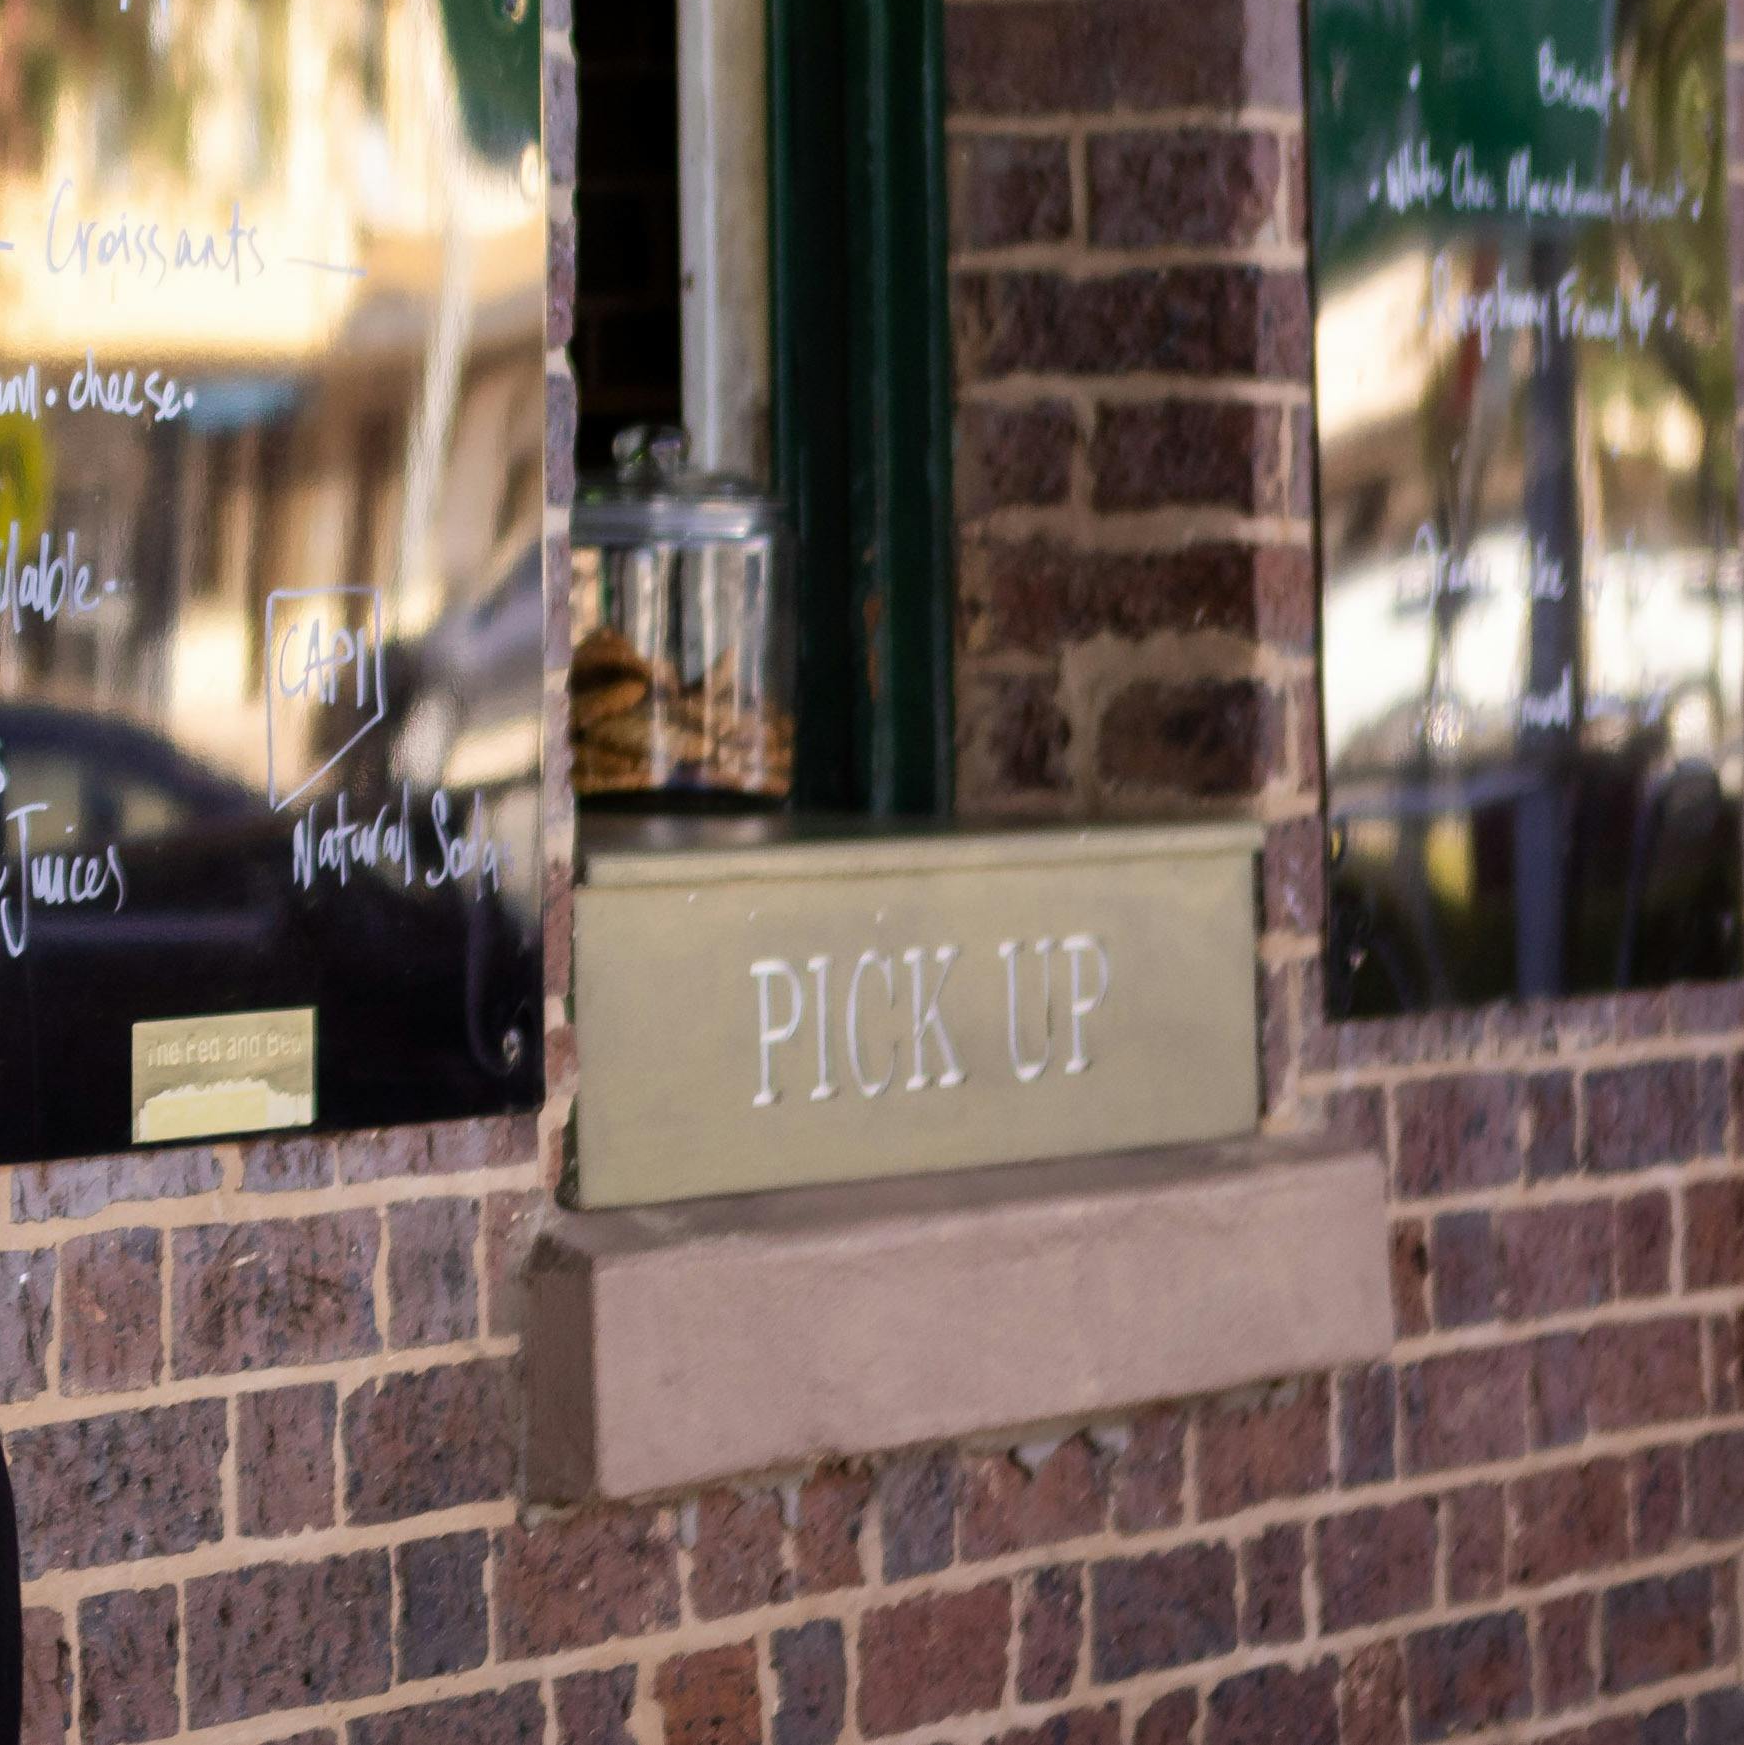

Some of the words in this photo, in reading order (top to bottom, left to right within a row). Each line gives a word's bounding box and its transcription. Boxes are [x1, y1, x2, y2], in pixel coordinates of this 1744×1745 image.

[44, 178, 265, 286] Croissants
[279, 618, 366, 710] CAPI
[293, 778, 412, 891] Natural
[750, 944, 966, 1108] PICK
[999, 932, 1110, 1082] UP
